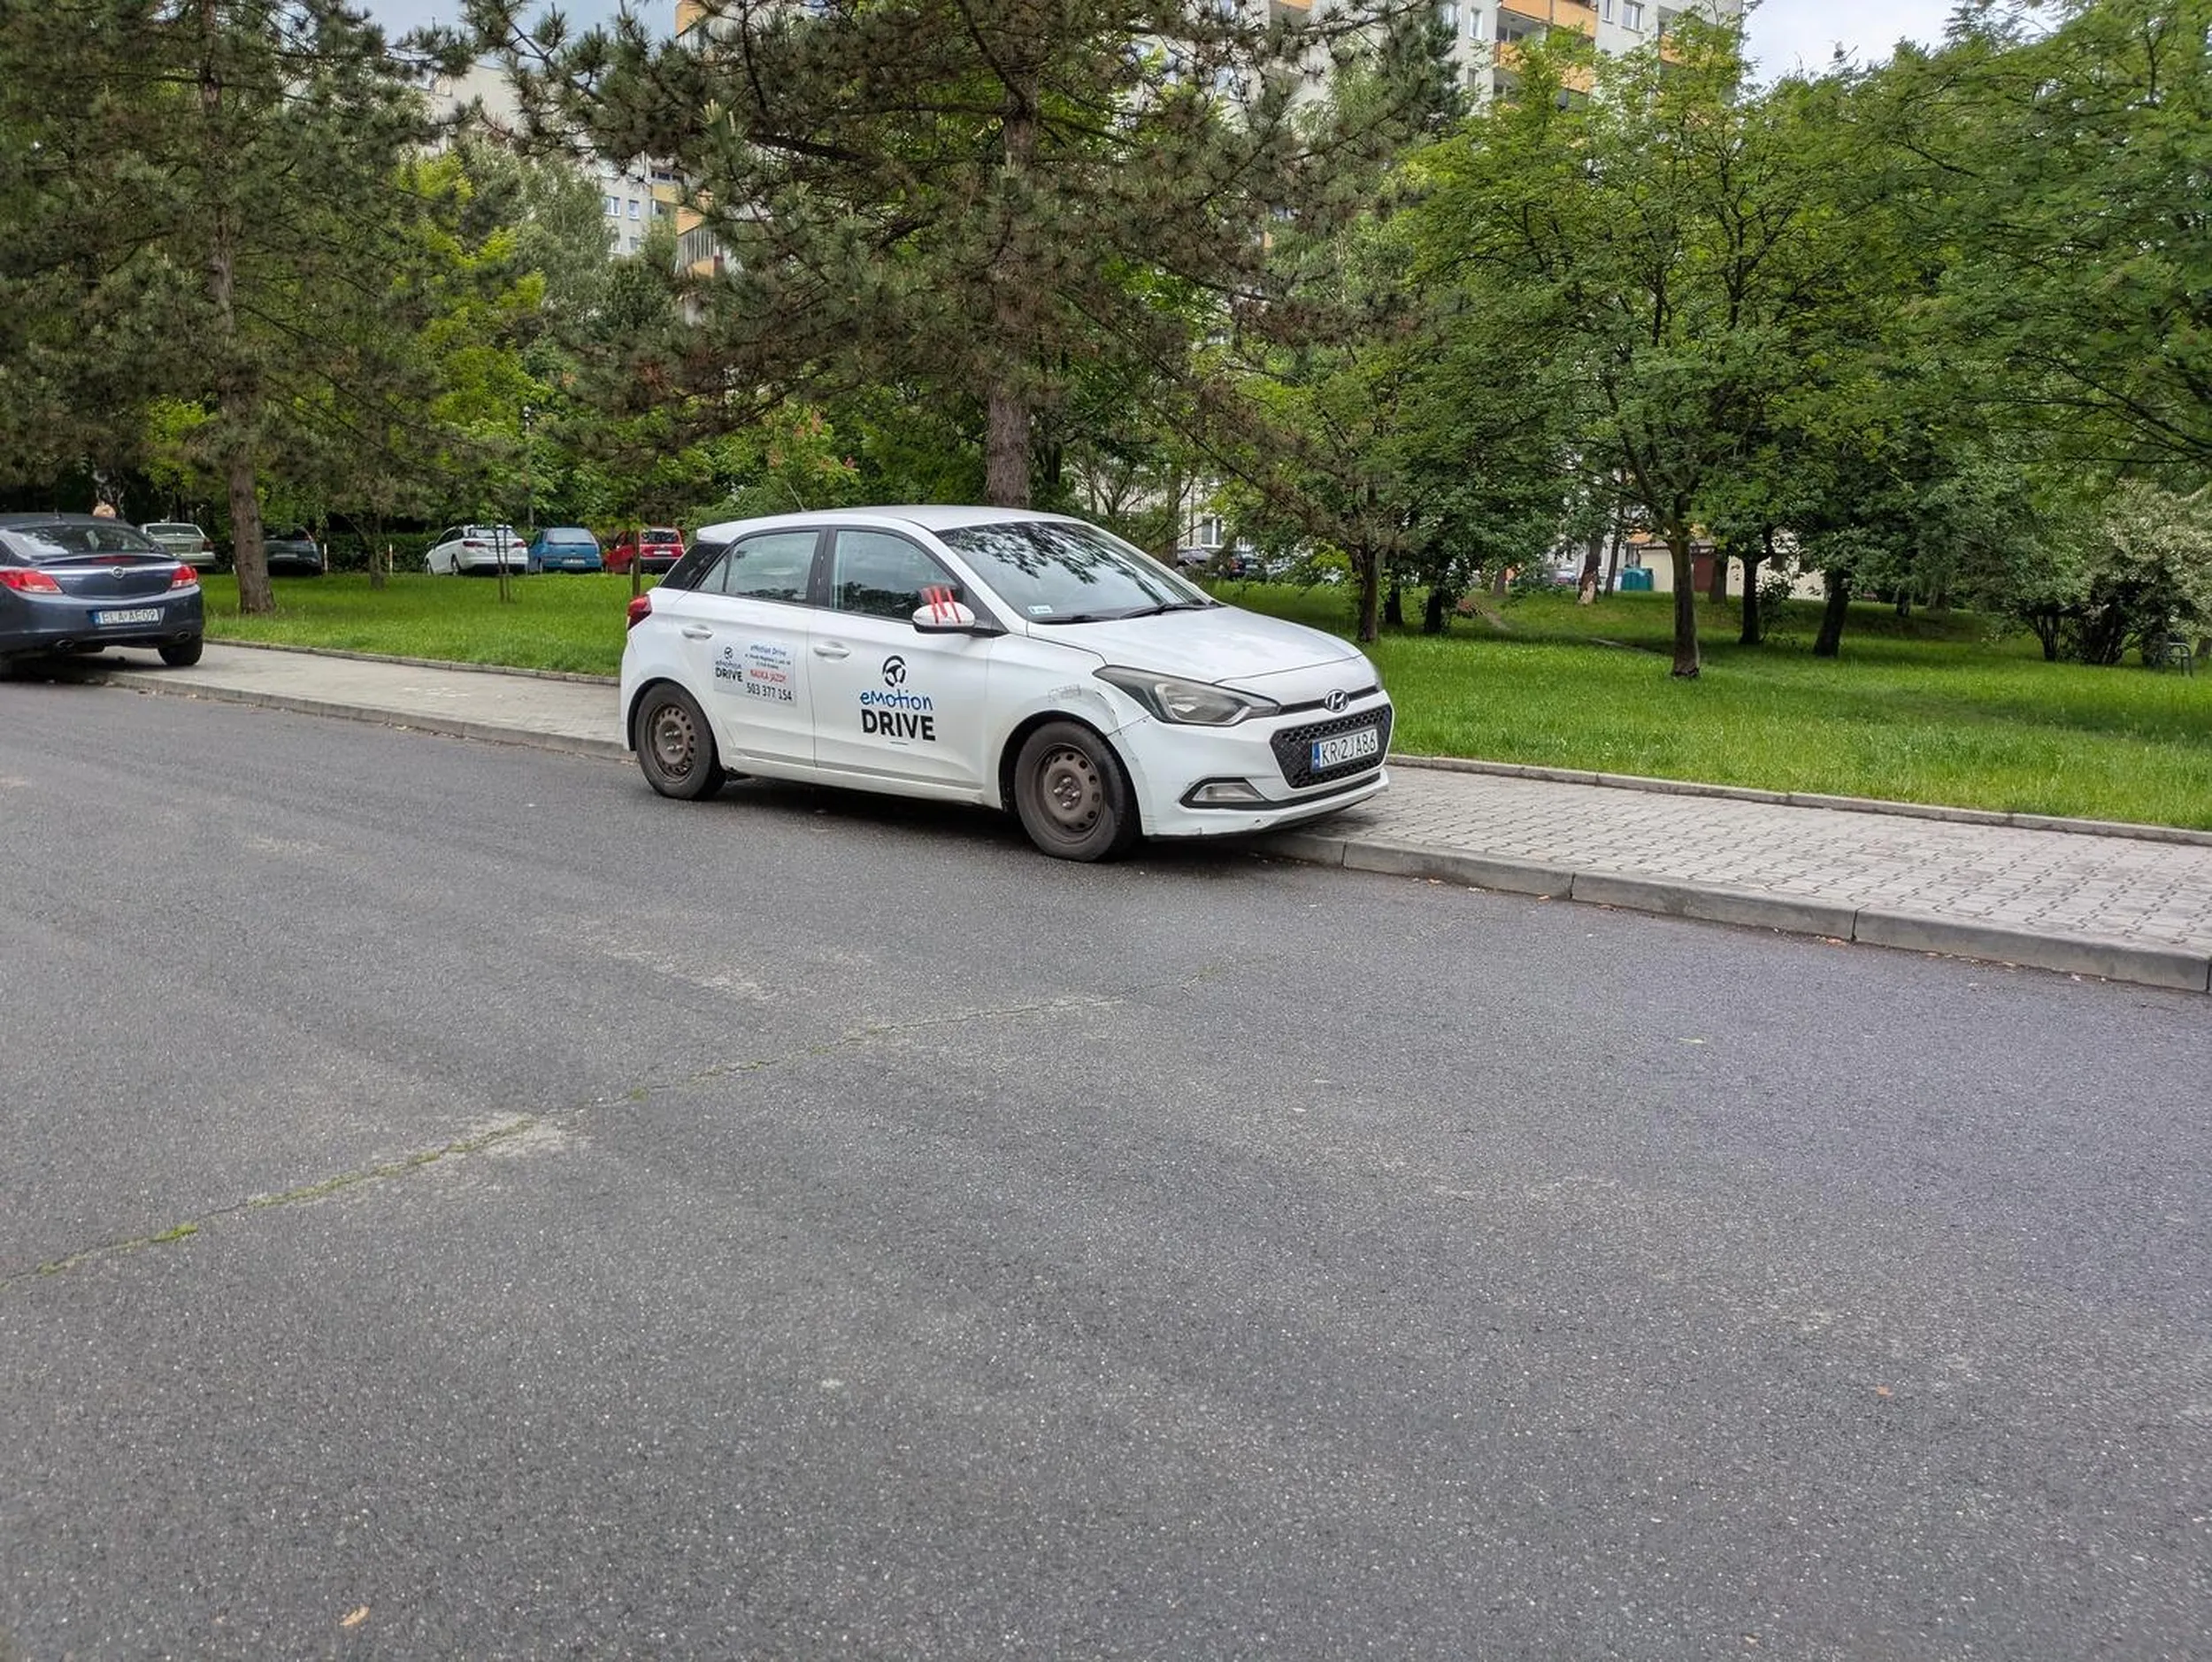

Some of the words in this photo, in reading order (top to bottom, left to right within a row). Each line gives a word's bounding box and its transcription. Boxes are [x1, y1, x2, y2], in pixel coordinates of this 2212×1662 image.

[715, 667, 743, 682] DRIVE
[746, 682, 760, 696] 503
[762, 685, 776, 698] 377
[778, 689, 793, 701] 154
[859, 689, 933, 711] eMotion
[861, 709, 936, 742] DRIVE
